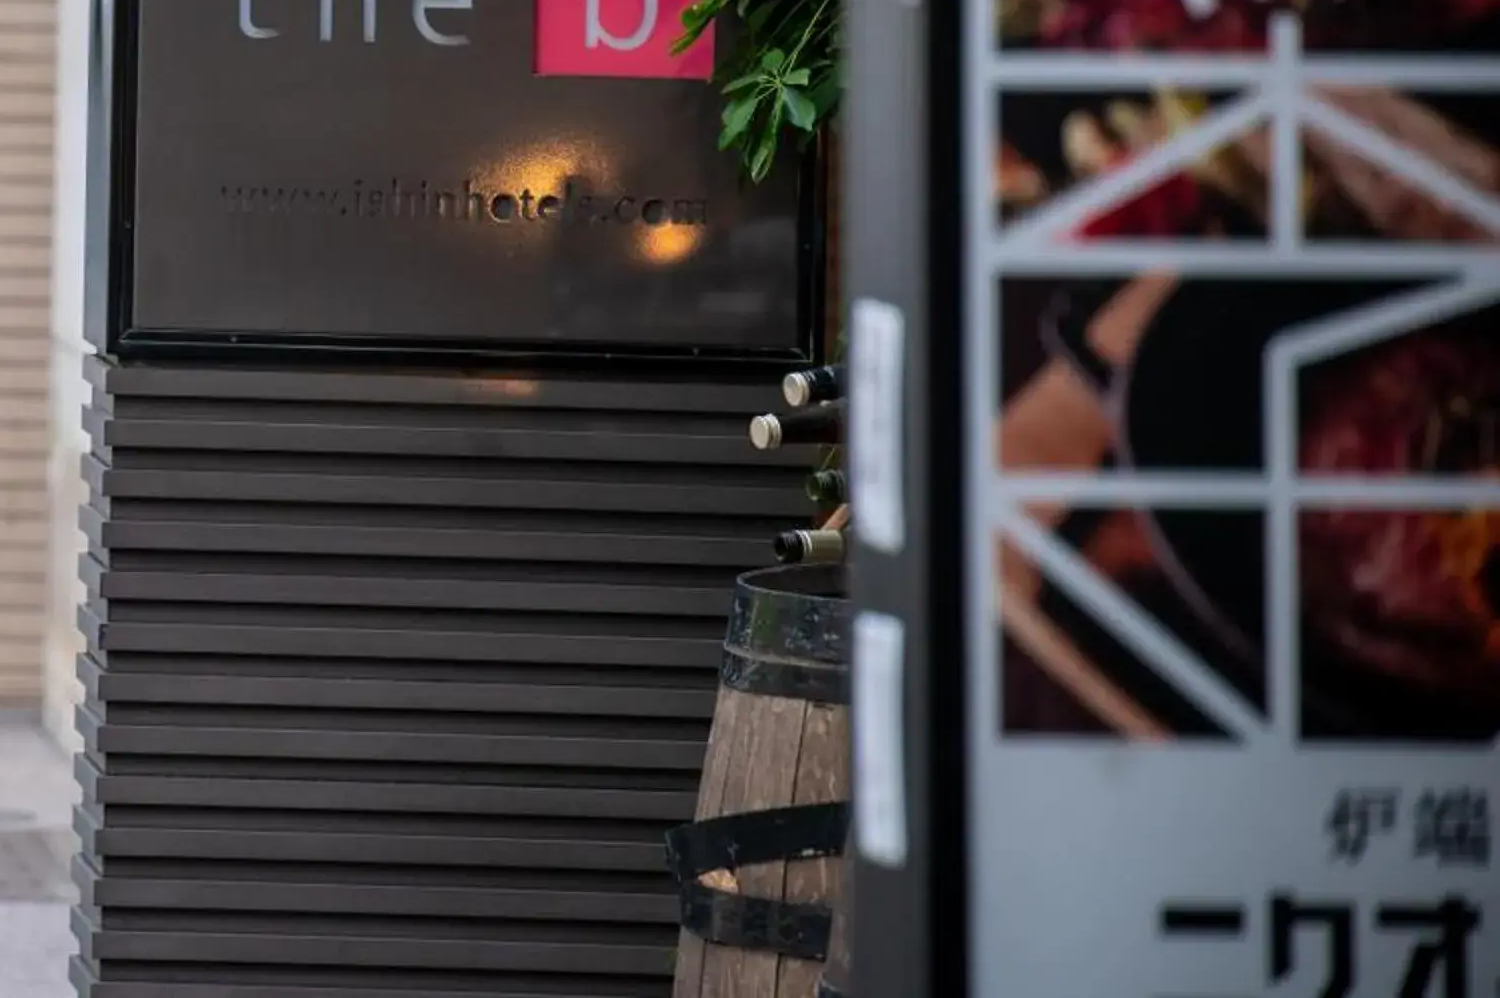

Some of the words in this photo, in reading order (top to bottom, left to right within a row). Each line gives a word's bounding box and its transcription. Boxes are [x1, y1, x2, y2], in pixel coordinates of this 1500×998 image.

[219, 176, 707, 226] www.ishinhotels.com
[1159, 892, 1500, 998] ニクオ
